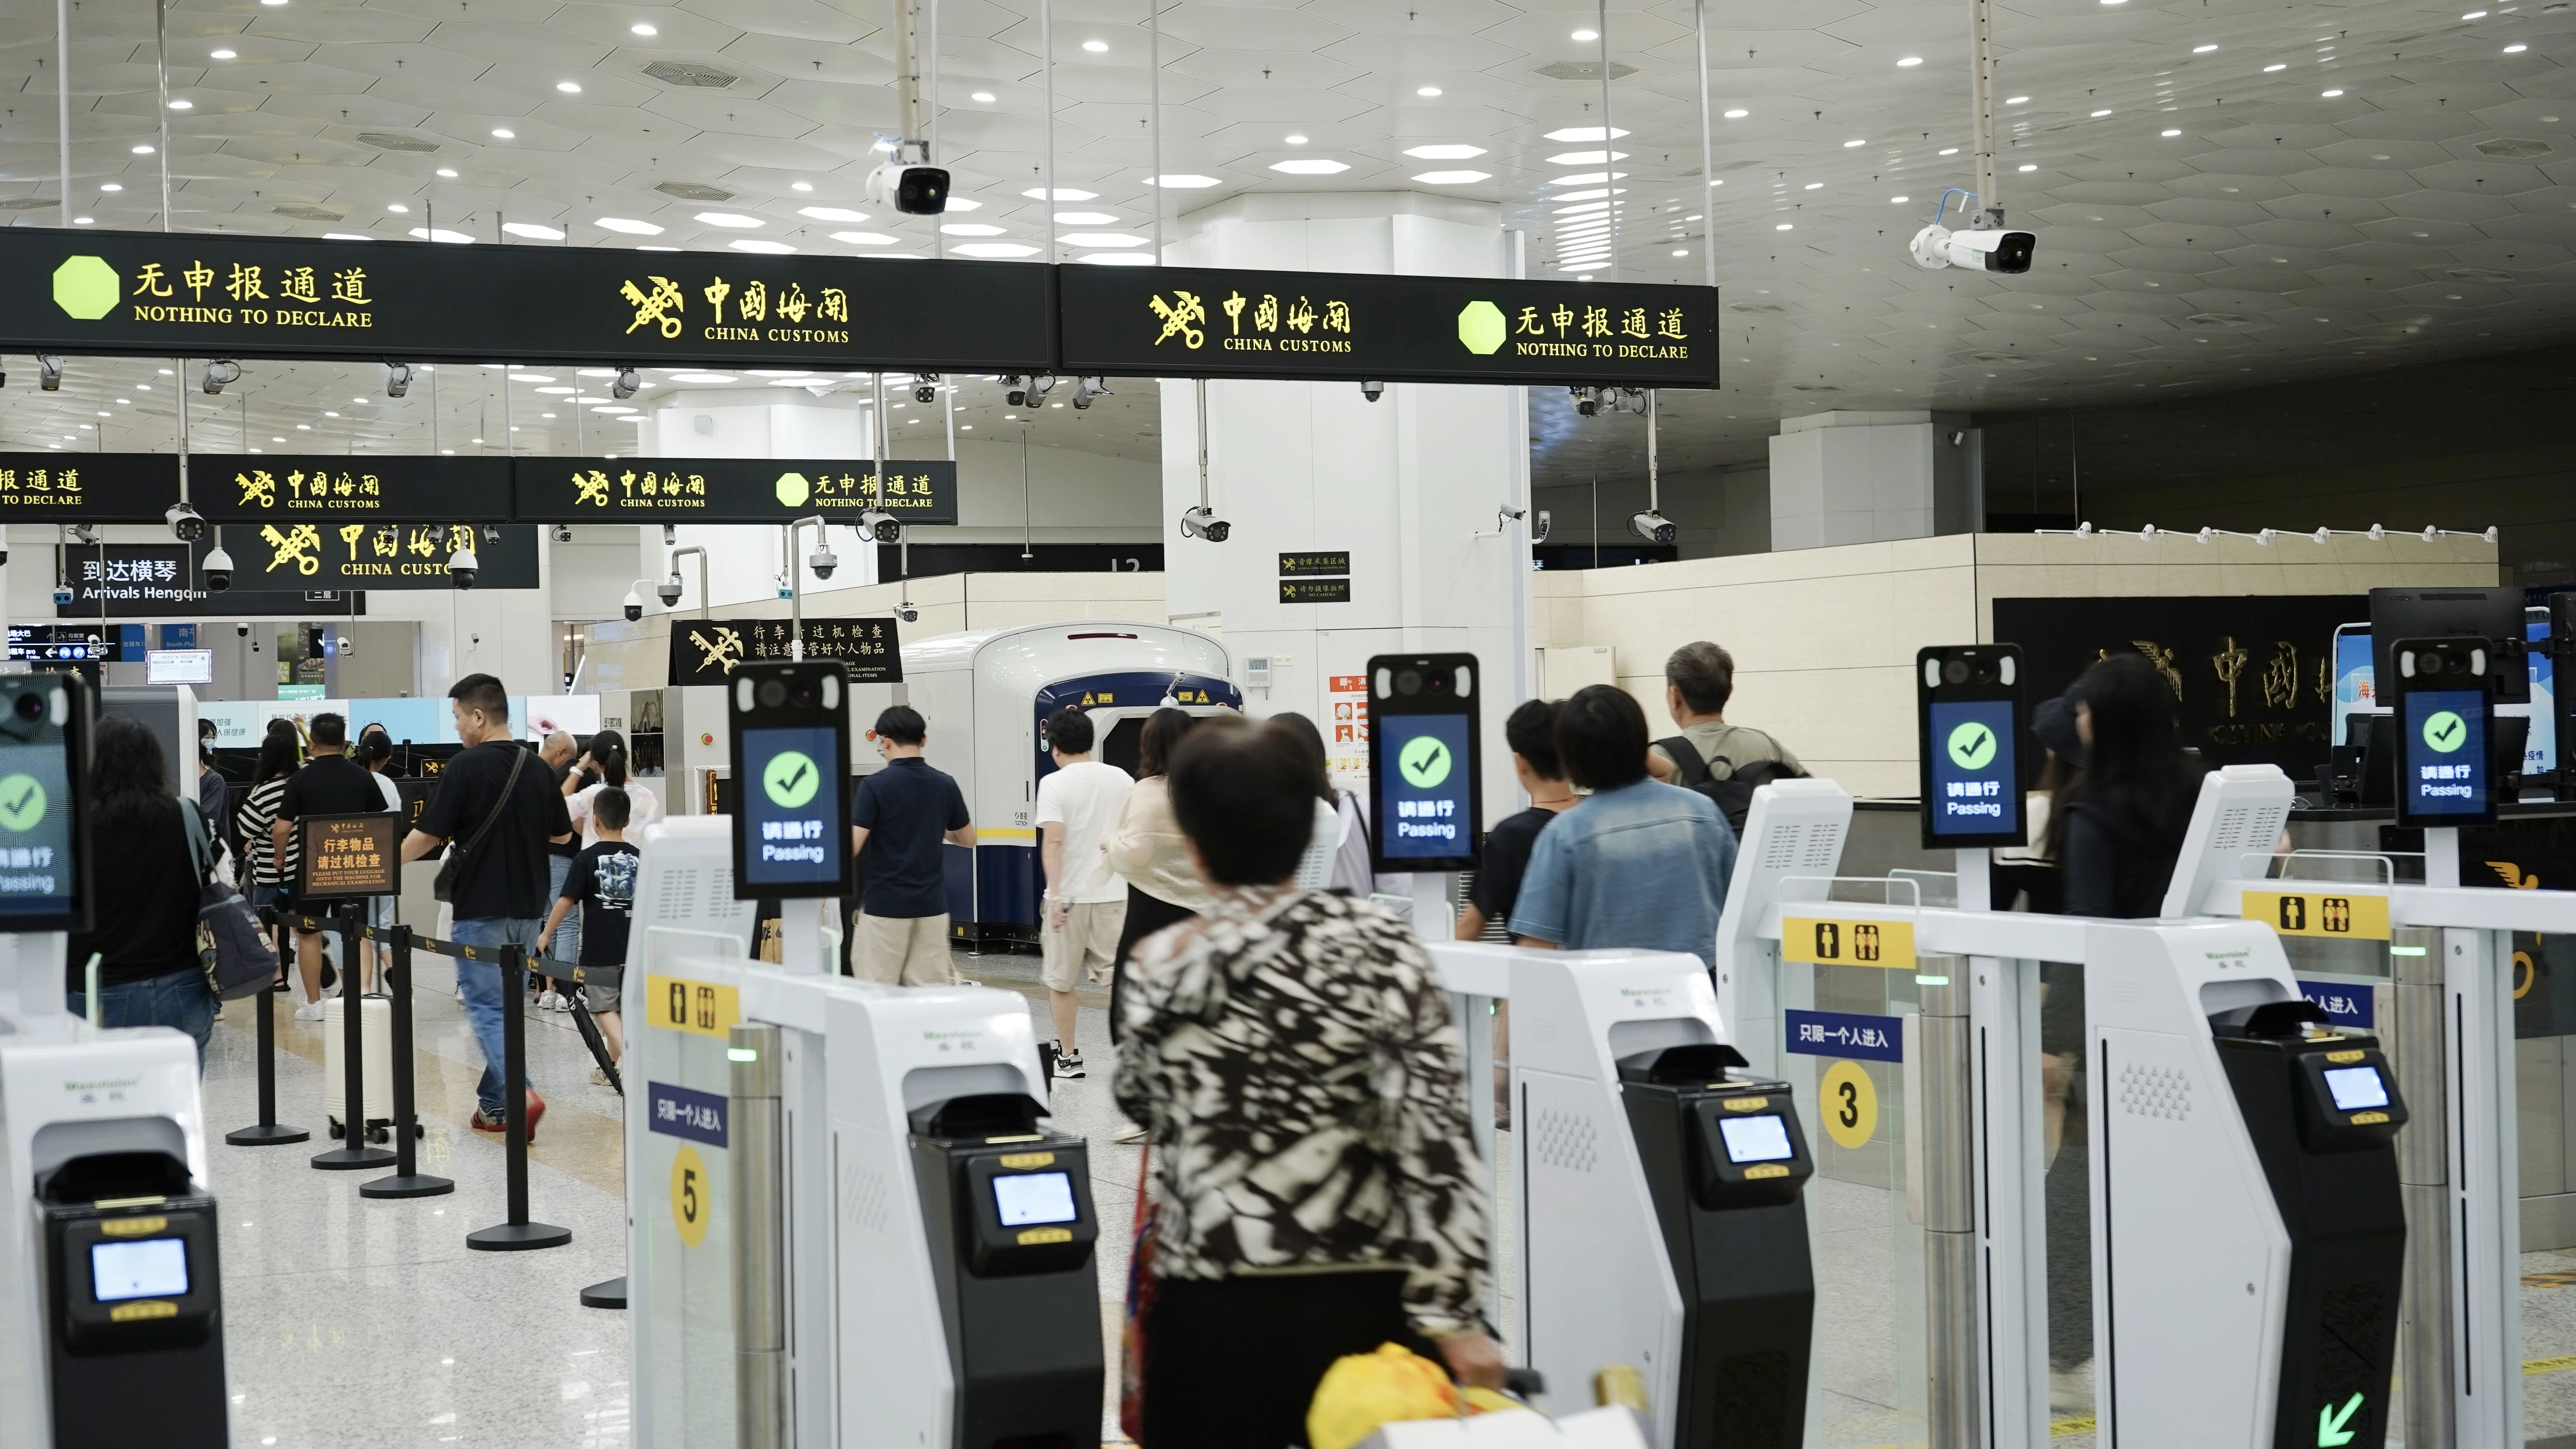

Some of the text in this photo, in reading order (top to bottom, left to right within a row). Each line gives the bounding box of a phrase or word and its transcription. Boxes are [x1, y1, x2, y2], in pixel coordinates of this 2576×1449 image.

[132, 259, 373, 305] 无申报通道
[134, 305, 373, 327] NOTHING TO DECLARE
[1516, 303, 1688, 339] 无申报通道
[704, 327, 849, 343] CHINA CUSTOMS
[1224, 338, 1352, 353] CHINA CUSTOMS
[1516, 343, 1688, 359] NOTHING TO DECLARE
[814, 475, 933, 498] 无申报通道
[2, 495, 82, 505] TO DECLARE
[288, 500, 380, 509] CHINA CUSTOMS
[620, 499, 705, 507] CHINA CUSTOMS
[815, 498, 864, 507] NOTHING
[341, 564, 451, 575] CHINA CUST
[1298, 557, 1346, 566] 音像采集区域
[82, 560, 176, 582] 到达横琴
[82, 586, 140, 598] Arrivals
[1947, 782, 2000, 797] 请通行
[2421, 784, 2472, 797] Passing
[1397, 800, 1455, 818] 请通行
[1947, 801, 2001, 817] Passing
[1398, 822, 1455, 840] Passing
[324, 837, 374, 853] 行李物品
[317, 853, 381, 870] 请过机检查
[762, 845, 824, 864] Passing
[1800, 1024, 1889, 1048] 只限一个人进入
[1839, 1082, 1858, 1128] 3
[658, 1099, 721, 1131] 只限一个人进入
[683, 1168, 696, 1224] 5
